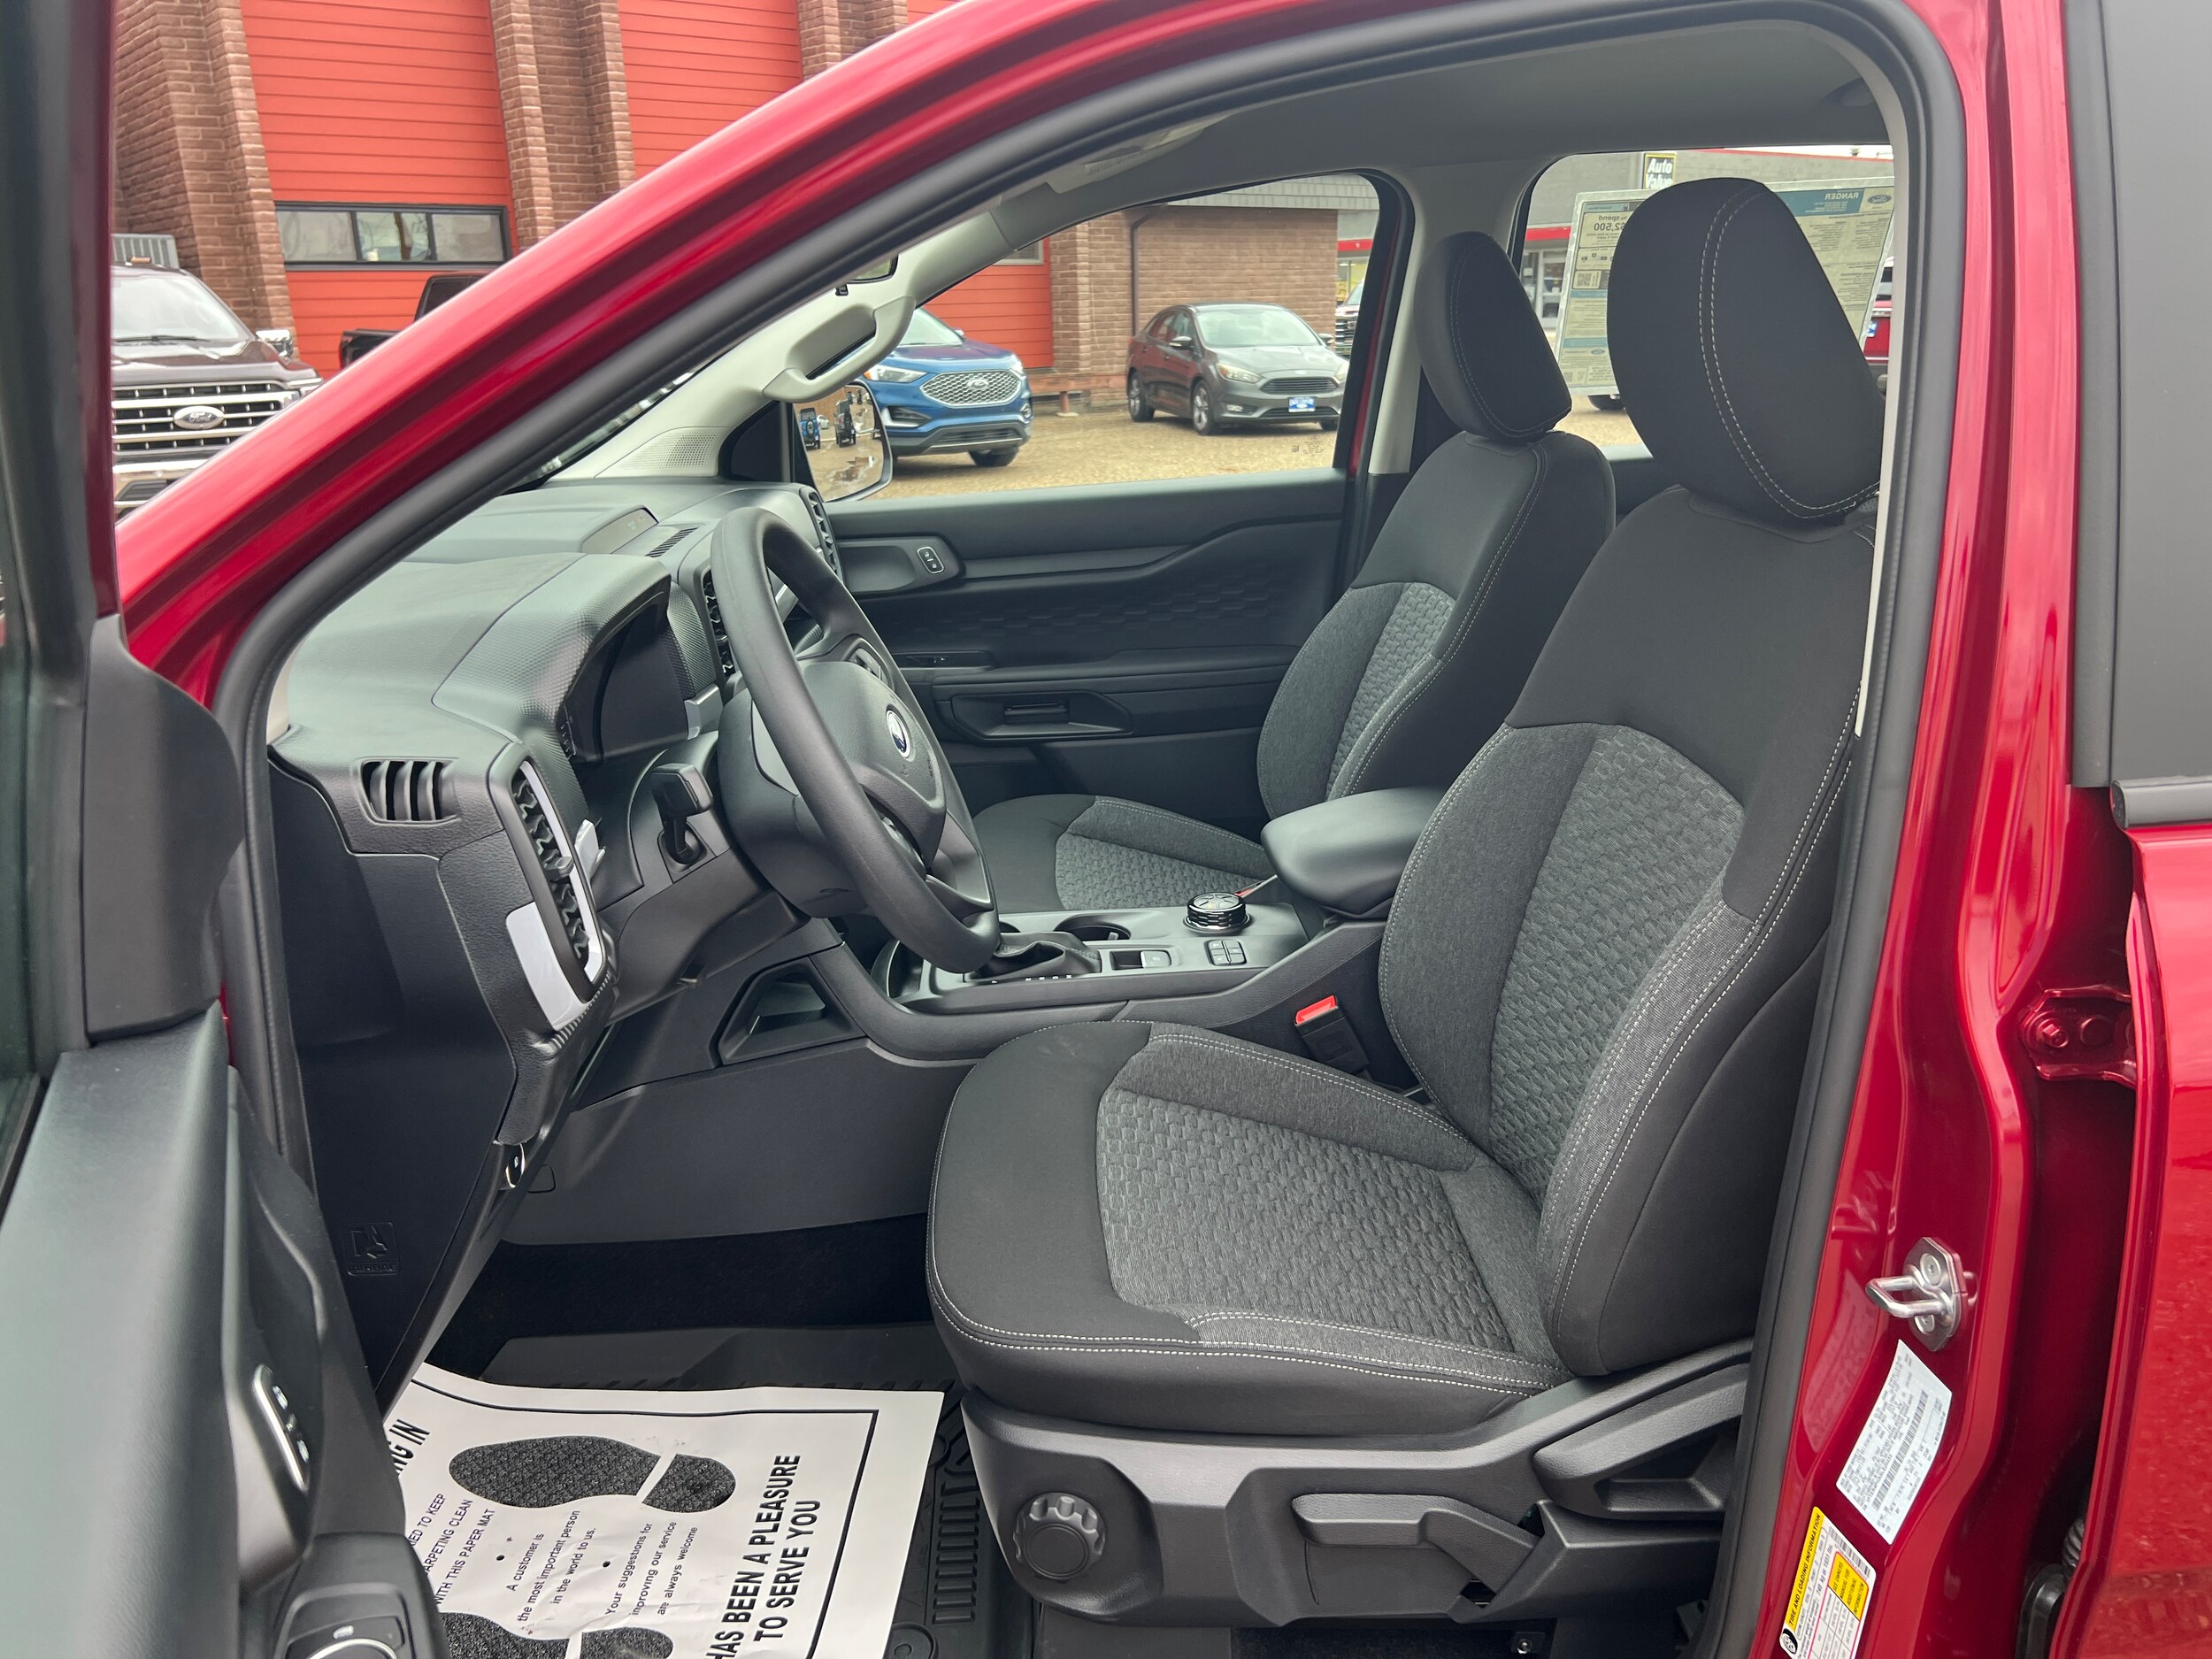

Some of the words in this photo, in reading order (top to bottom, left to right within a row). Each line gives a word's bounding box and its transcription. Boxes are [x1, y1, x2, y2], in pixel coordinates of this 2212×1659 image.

[1646, 173, 1673, 189] Value
[1647, 157, 1673, 174] Auto
[388, 1418, 430, 1445] IN
[417, 1516, 431, 1532] TO
[426, 1494, 446, 1515] KEEP
[748, 1455, 801, 1545] PLEASURE
[786, 1500, 821, 1540] YOU
[424, 1529, 454, 1575] ARPETING
[449, 1500, 472, 1527] CLEAN
[434, 1582, 453, 1605] WITH
[445, 1560, 465, 1580] THIS
[459, 1529, 484, 1557] PAPER
[477, 1509, 495, 1531] MAT
[513, 1542, 539, 1581] customer
[651, 1550, 663, 1566] our
[658, 1522, 677, 1548] service
[742, 1553, 772, 1564] A
[1797, 1563, 1809, 1594] LOADING
[1806, 1513, 1821, 1563] INFORMATION
[517, 1607, 532, 1622] the
[527, 1581, 545, 1603] most
[537, 1540, 565, 1578] important
[561, 1510, 580, 1538] person
[549, 1595, 563, 1604] in
[557, 1578, 571, 1592] the
[566, 1554, 583, 1575] world
[577, 1541, 588, 1550] to
[584, 1527, 596, 1540] us.
[605, 1592, 622, 1615] Your
[618, 1536, 647, 1588] suggestions
[640, 1523, 653, 1533] for
[657, 1602, 670, 1615] are
[664, 1564, 682, 1598] always
[678, 1527, 698, 1561] welcome
[765, 1547, 810, 1608] SERVE
[721, 1571, 764, 1623] BEEN
[753, 1616, 788, 1642] TO
